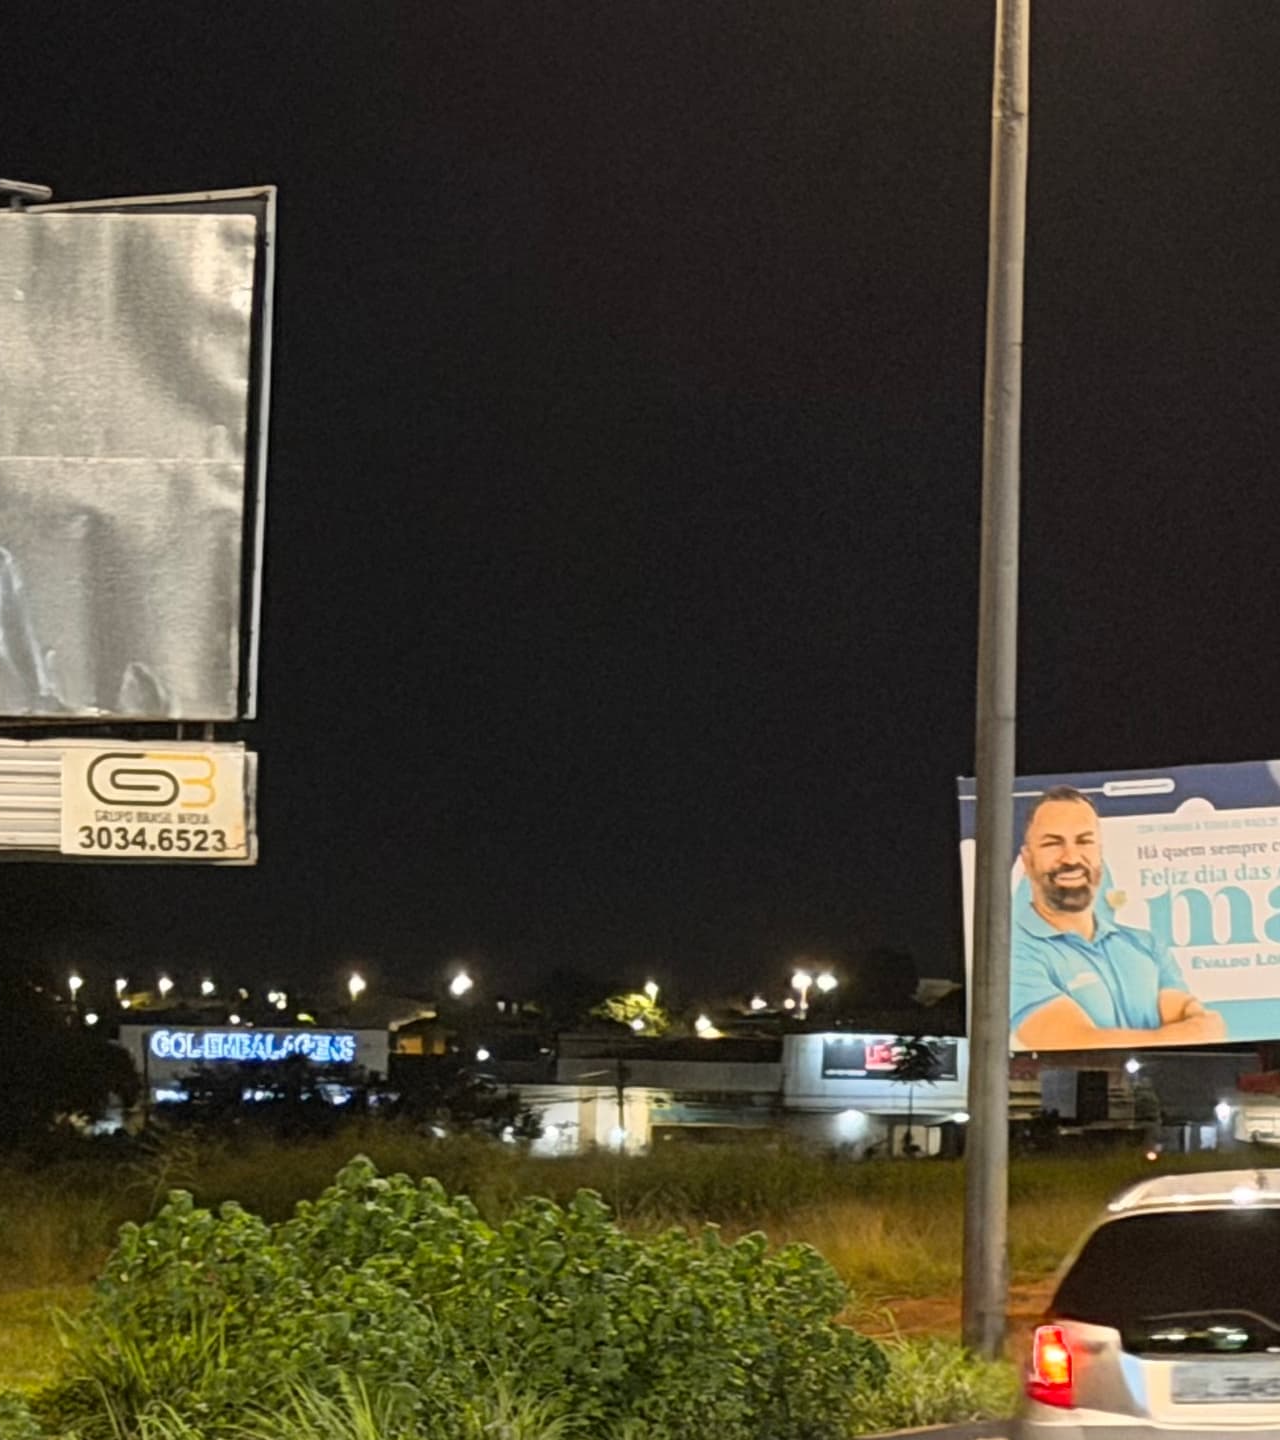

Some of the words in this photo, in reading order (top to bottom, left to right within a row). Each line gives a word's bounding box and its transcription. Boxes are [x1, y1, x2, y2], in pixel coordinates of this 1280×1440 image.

[94, 810, 134, 823] GRUPO
[136, 812, 173, 824] BRASIL
[78, 825, 227, 852] 3034.6523
[1137, 844, 1159, 860] Há
[1162, 845, 1207, 862] quem
[1210, 840, 1267, 858] sempre
[1139, 866, 1189, 887] Feliz
[1194, 863, 1229, 885] dia
[1234, 862, 1272, 882] das
